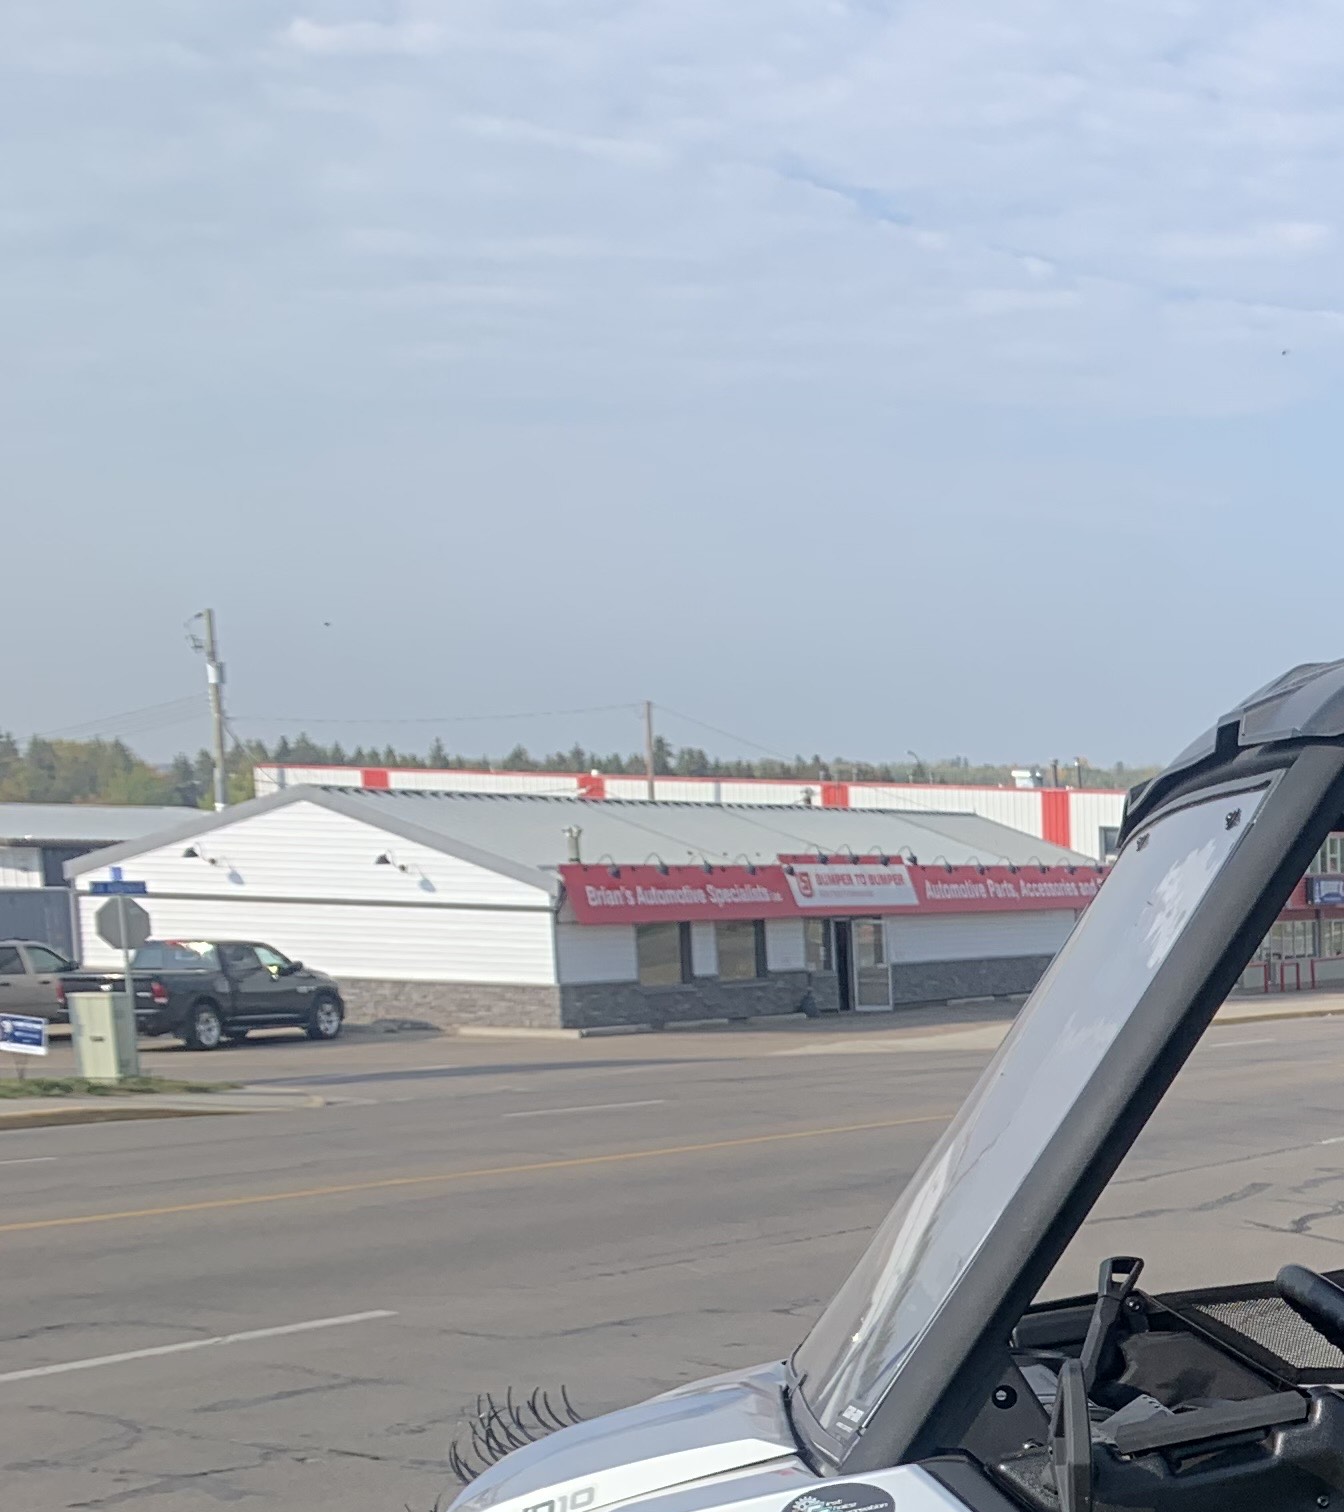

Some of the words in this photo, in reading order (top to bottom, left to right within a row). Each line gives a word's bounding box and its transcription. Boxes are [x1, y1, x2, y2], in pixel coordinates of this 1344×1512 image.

[815, 873, 853, 886] BUMPER
[854, 873, 867, 886] TO
[868, 873, 905, 886] BUMPER
[925, 880, 986, 899] Automotive
[986, 878, 1020, 899] Parts,
[1019, 879, 1078, 897] Accessories
[1078, 880, 1097, 896] and
[585, 885, 635, 907] Brian's
[636, 884, 707, 905] Automotive
[706, 883, 771, 907] Specialists
